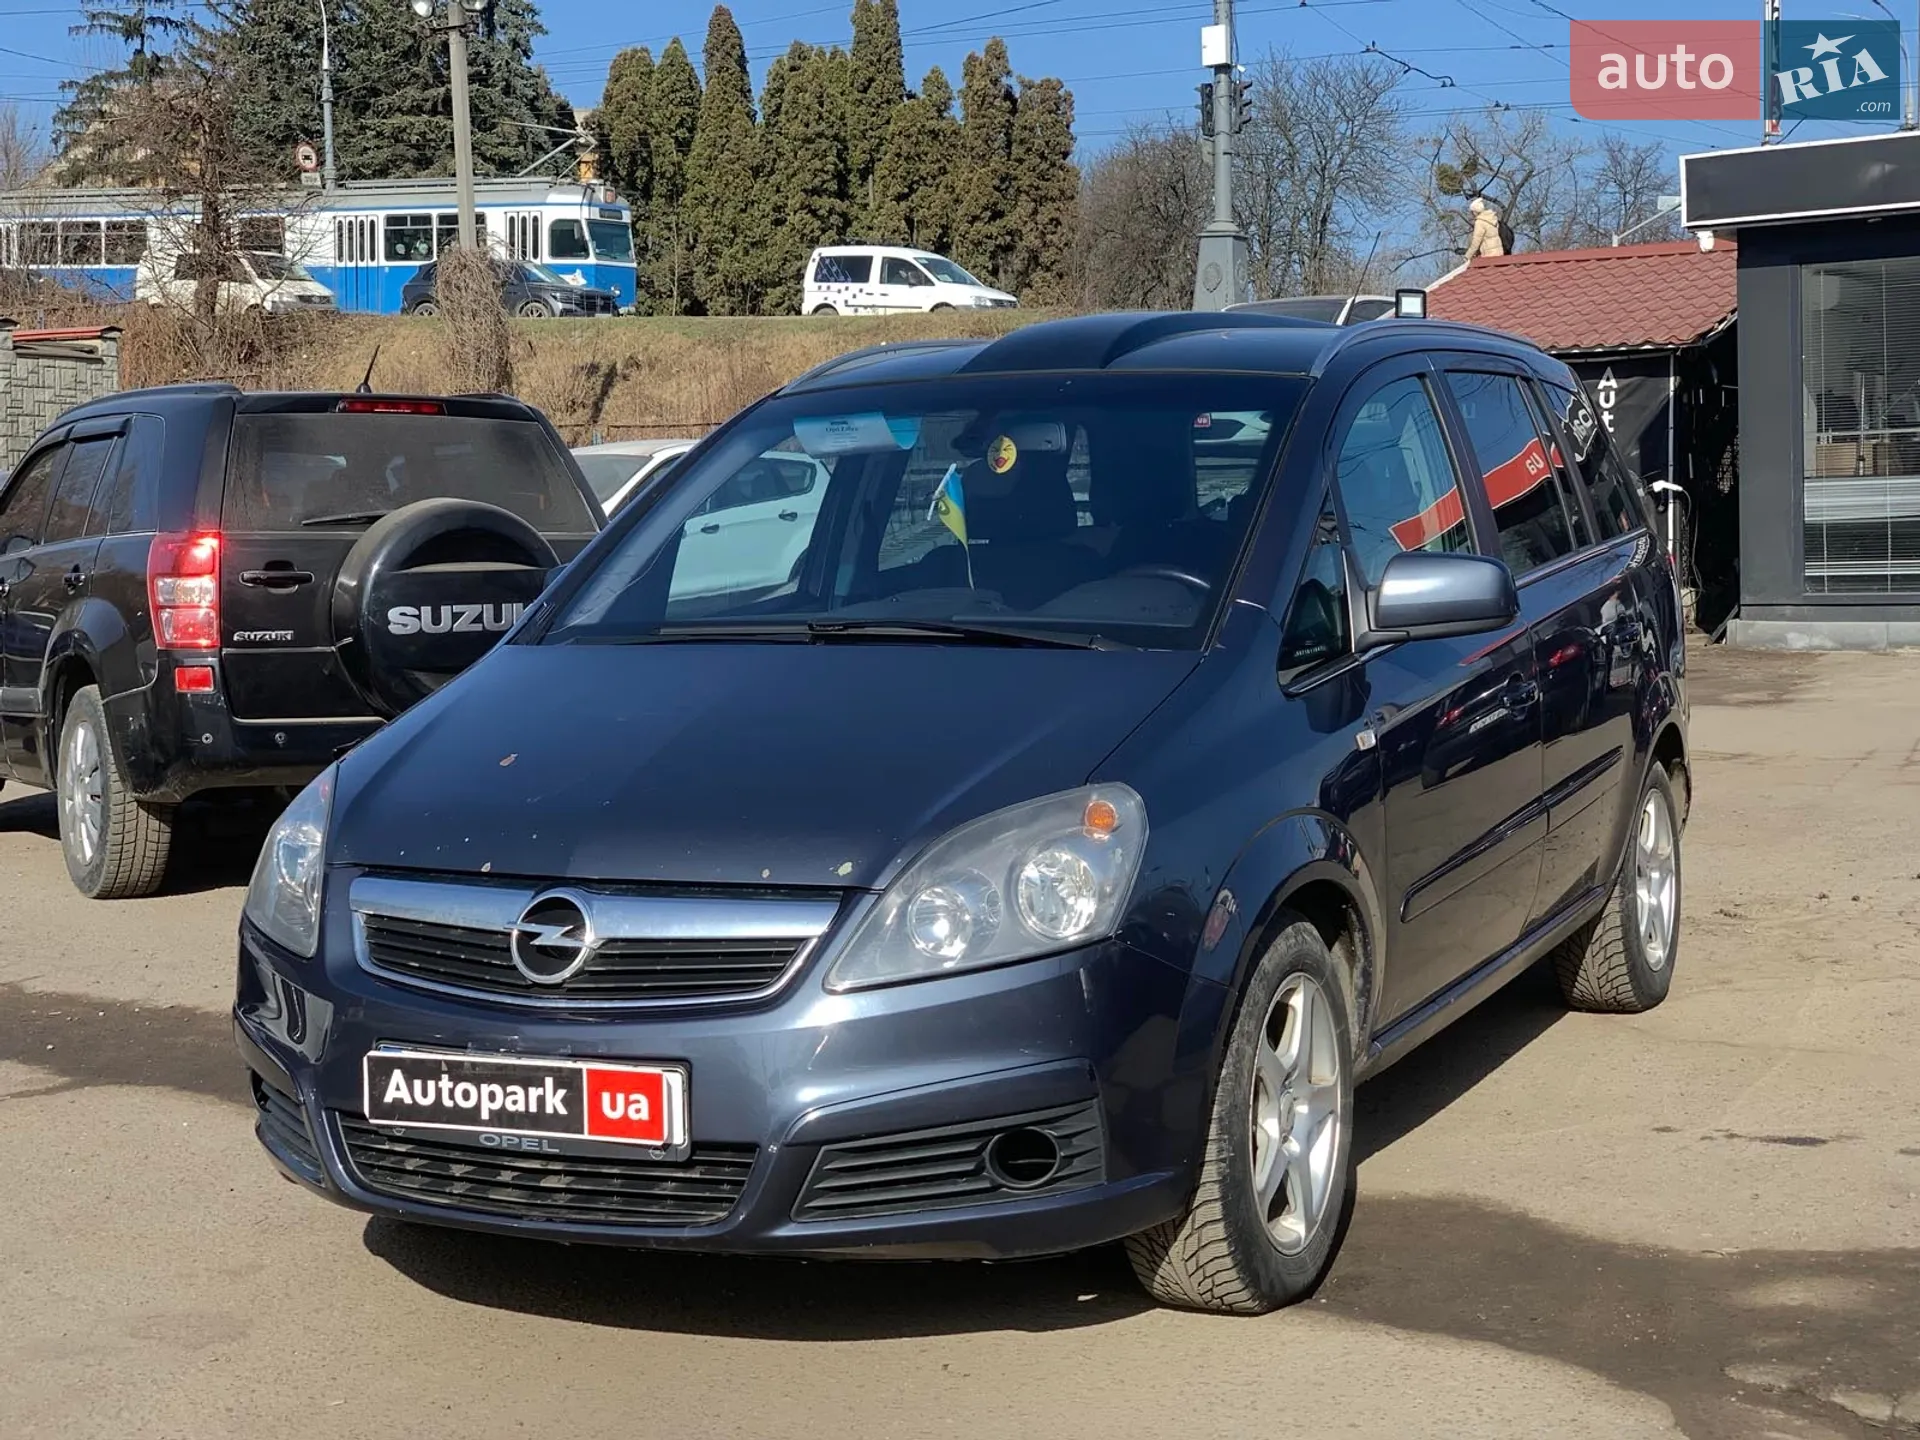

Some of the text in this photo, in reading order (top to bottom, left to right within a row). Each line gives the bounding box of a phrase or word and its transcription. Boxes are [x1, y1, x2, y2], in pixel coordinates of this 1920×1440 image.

[1597, 366, 1619, 433] Aut
[383, 1068, 649, 1121] Autopark ua
[478, 1133, 560, 1153] OPEL
